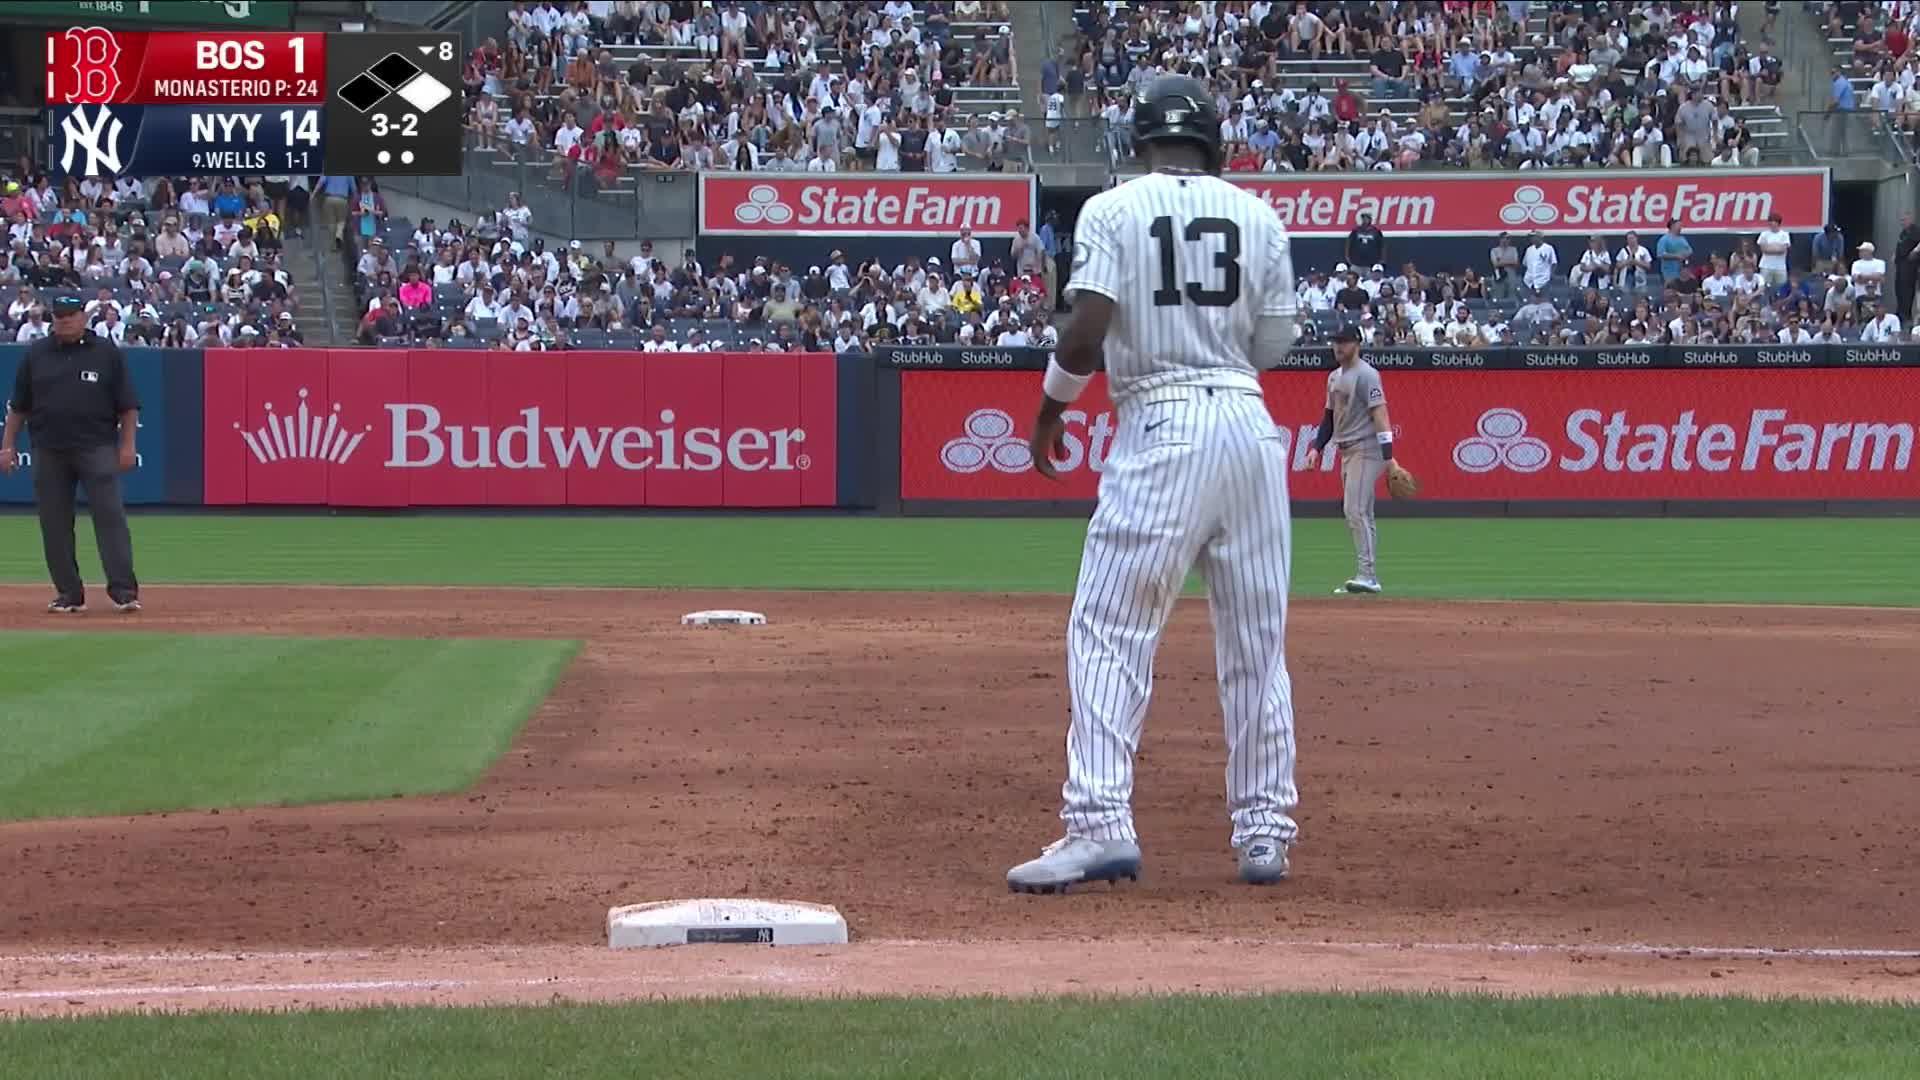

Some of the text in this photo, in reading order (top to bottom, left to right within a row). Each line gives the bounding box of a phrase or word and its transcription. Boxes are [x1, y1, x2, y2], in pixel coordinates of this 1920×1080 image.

[1243, 188, 1335, 225] ate
[1150, 215, 1240, 307] 13
[891, 352, 943, 364] StubHub
[961, 352, 1013, 364] StubHub
[1280, 353, 1321, 366] ubHub
[1431, 354, 1484, 366] StubHub
[1526, 354, 1579, 366] StubHub
[1597, 353, 1650, 365] StubHub
[1684, 352, 1738, 364] StubHub
[1757, 351, 1811, 363] StubHub
[1846, 350, 1901, 362] StubHub
[384, 403, 806, 472] Budweiser
